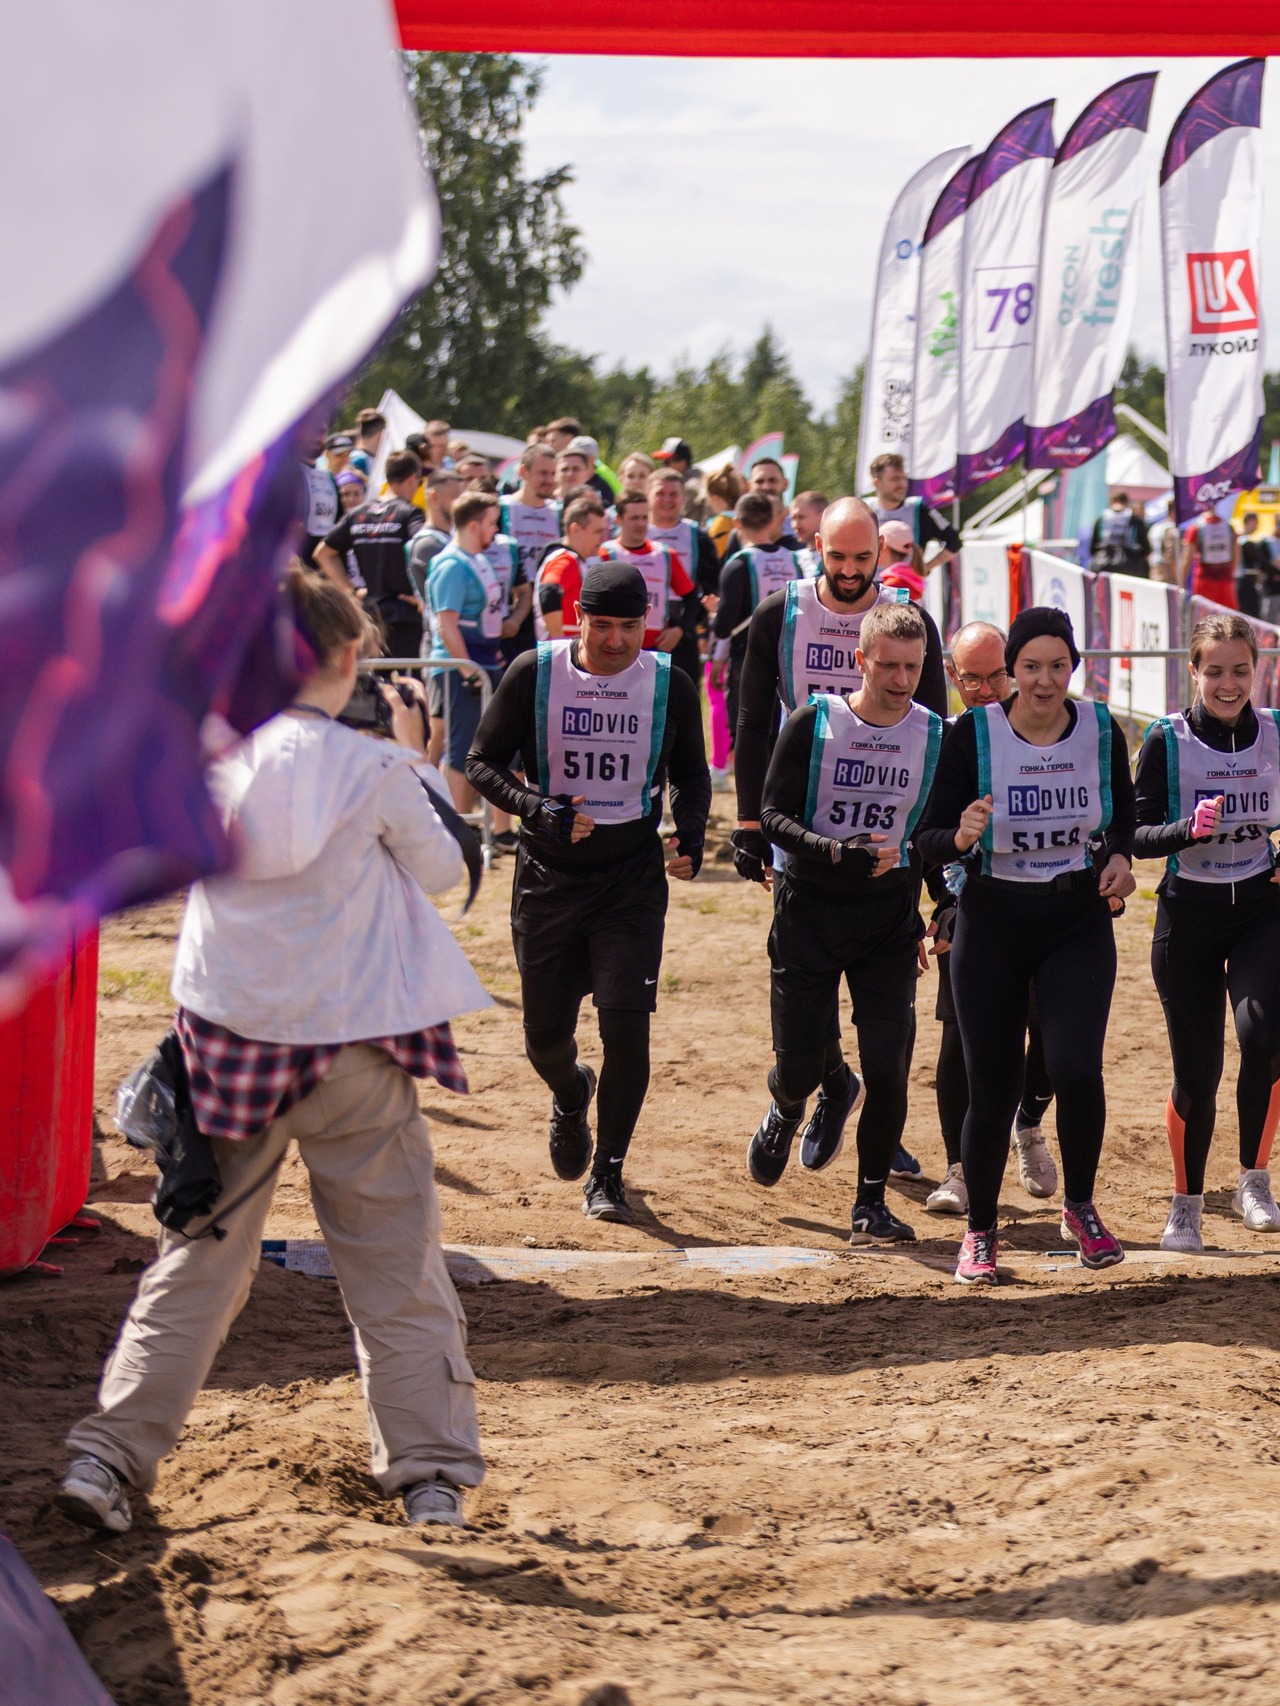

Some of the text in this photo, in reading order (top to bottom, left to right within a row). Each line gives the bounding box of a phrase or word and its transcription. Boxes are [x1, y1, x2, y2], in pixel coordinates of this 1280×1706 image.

[1080, 208, 1128, 327] fresh
[987, 282, 1034, 333] 78
[1189, 336, 1259, 356] ЛУКОЙЛ
[820, 627, 841, 635] ГОНКА
[601, 690, 628, 698] ГЕРОЕВ
[563, 710, 639, 735] RODVIG
[851, 742, 901, 751] ГОНКА ГЕРОЕВ
[563, 750, 630, 781] 5161
[835, 761, 910, 789] RODVIG
[1020, 762, 1074, 773] ГОНКА ГЕРОЕВ
[1232, 768, 1257, 776] ГЕРОЕВ
[1010, 785, 1089, 814] RODVIG
[1199, 791, 1269, 814] DVIG
[829, 800, 897, 830] 5163
[1029, 858, 1071, 869] ГАЗПРОМБАНК
[1214, 859, 1253, 869] ГАЗПРОМБАНК
